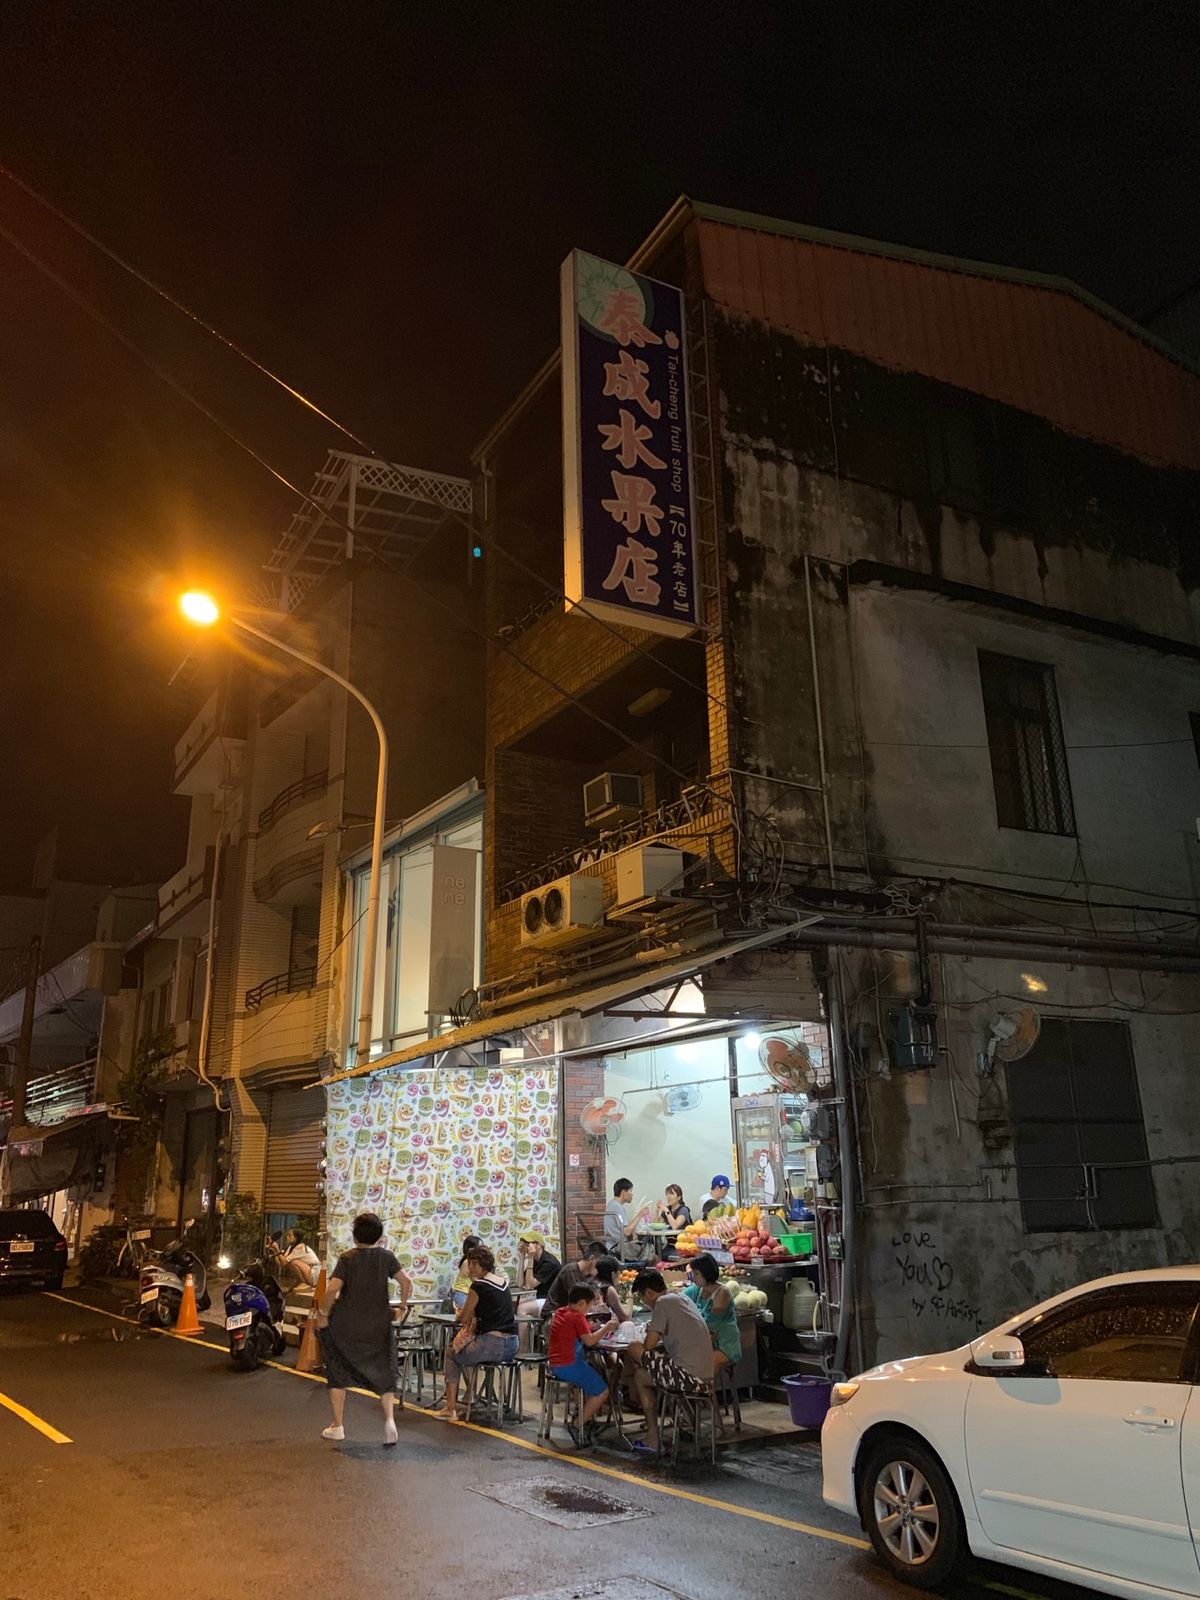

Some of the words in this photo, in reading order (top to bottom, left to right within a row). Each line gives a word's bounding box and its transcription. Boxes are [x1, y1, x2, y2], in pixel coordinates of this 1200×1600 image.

[666, 353, 682, 421] Tai-cheng
[597, 288, 668, 607] 泰成水果店
[670, 423, 683, 455] fruit
[670, 458, 684, 494] shop
[912, 1298, 927, 1317] by
